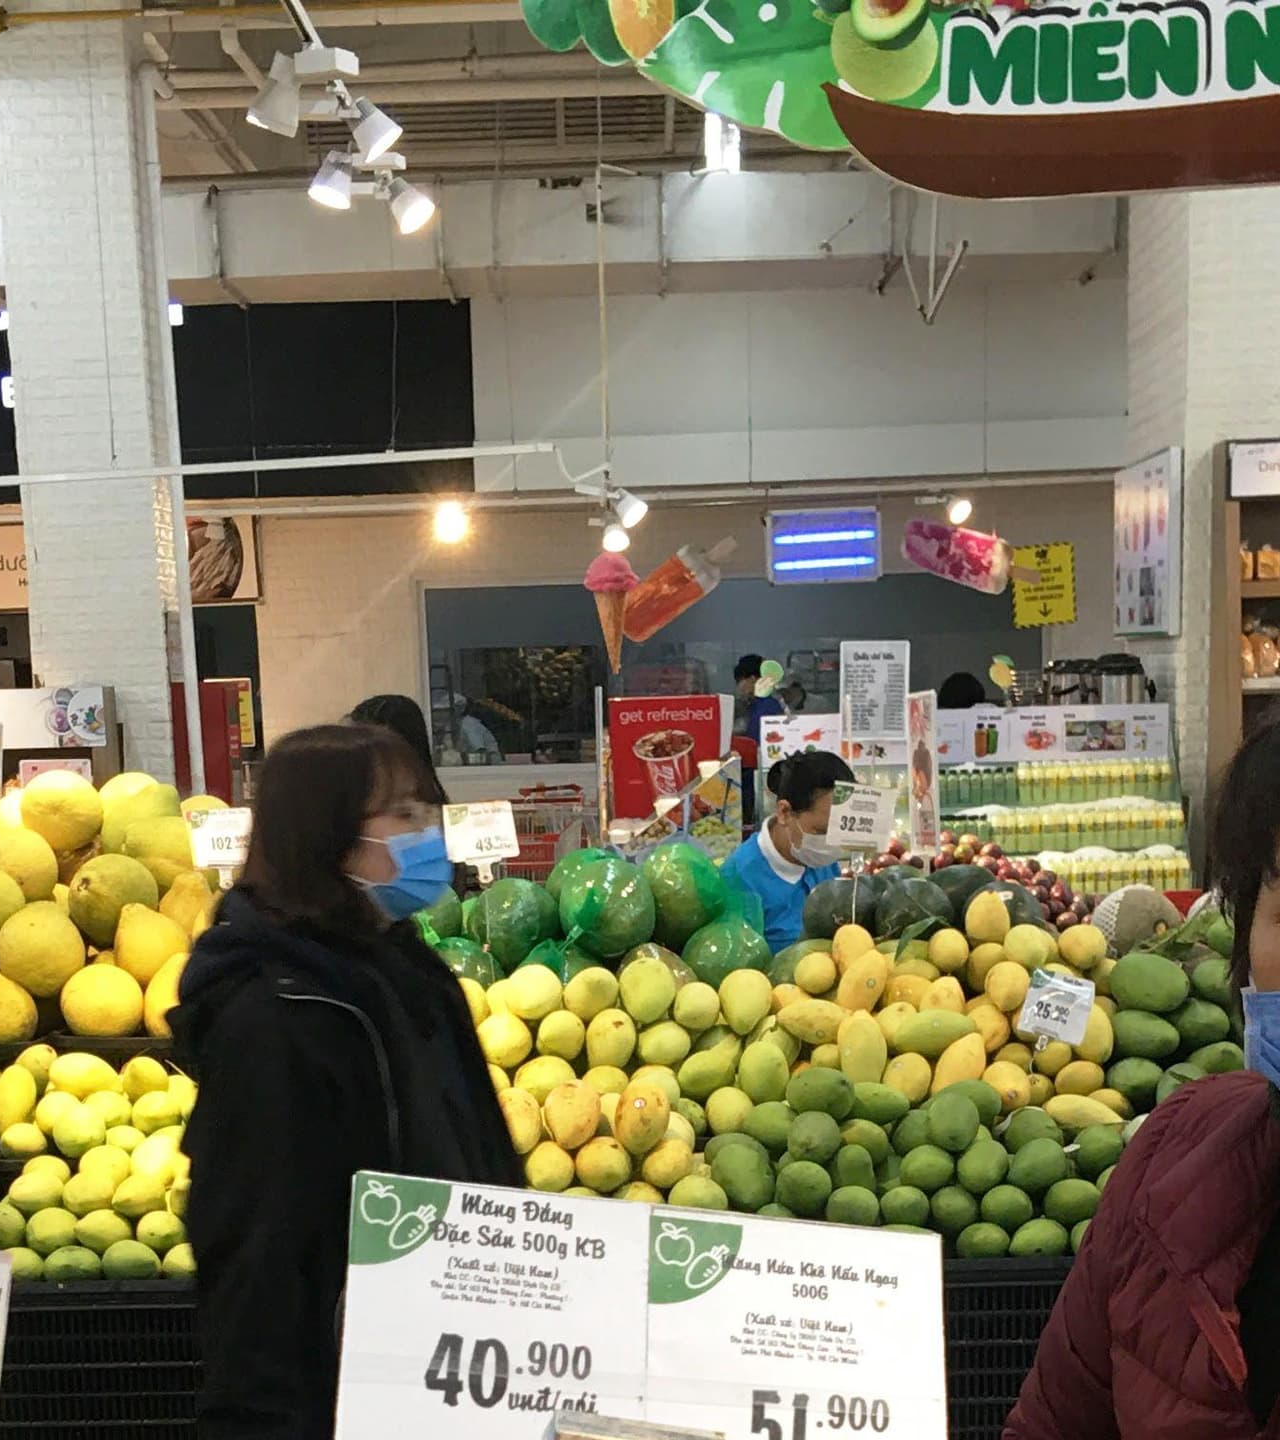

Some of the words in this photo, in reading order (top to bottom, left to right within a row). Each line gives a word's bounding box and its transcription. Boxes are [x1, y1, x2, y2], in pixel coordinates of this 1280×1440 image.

[619, 709, 644, 725] get
[647, 707, 713, 721] refreshed
[462, 1192, 516, 1224] Măng
[523, 1199, 573, 1230] Đắng
[432, 1220, 471, 1248] Đặc
[477, 1225, 516, 1249] Sản
[523, 1231, 568, 1260] 500g
[575, 1236, 606, 1260] KB
[792, 1283, 829, 1301] 500G
[832, 1264, 860, 1283] Nấu
[864, 1268, 899, 1290] Ngay
[424, 1331, 594, 1410] 40.900
